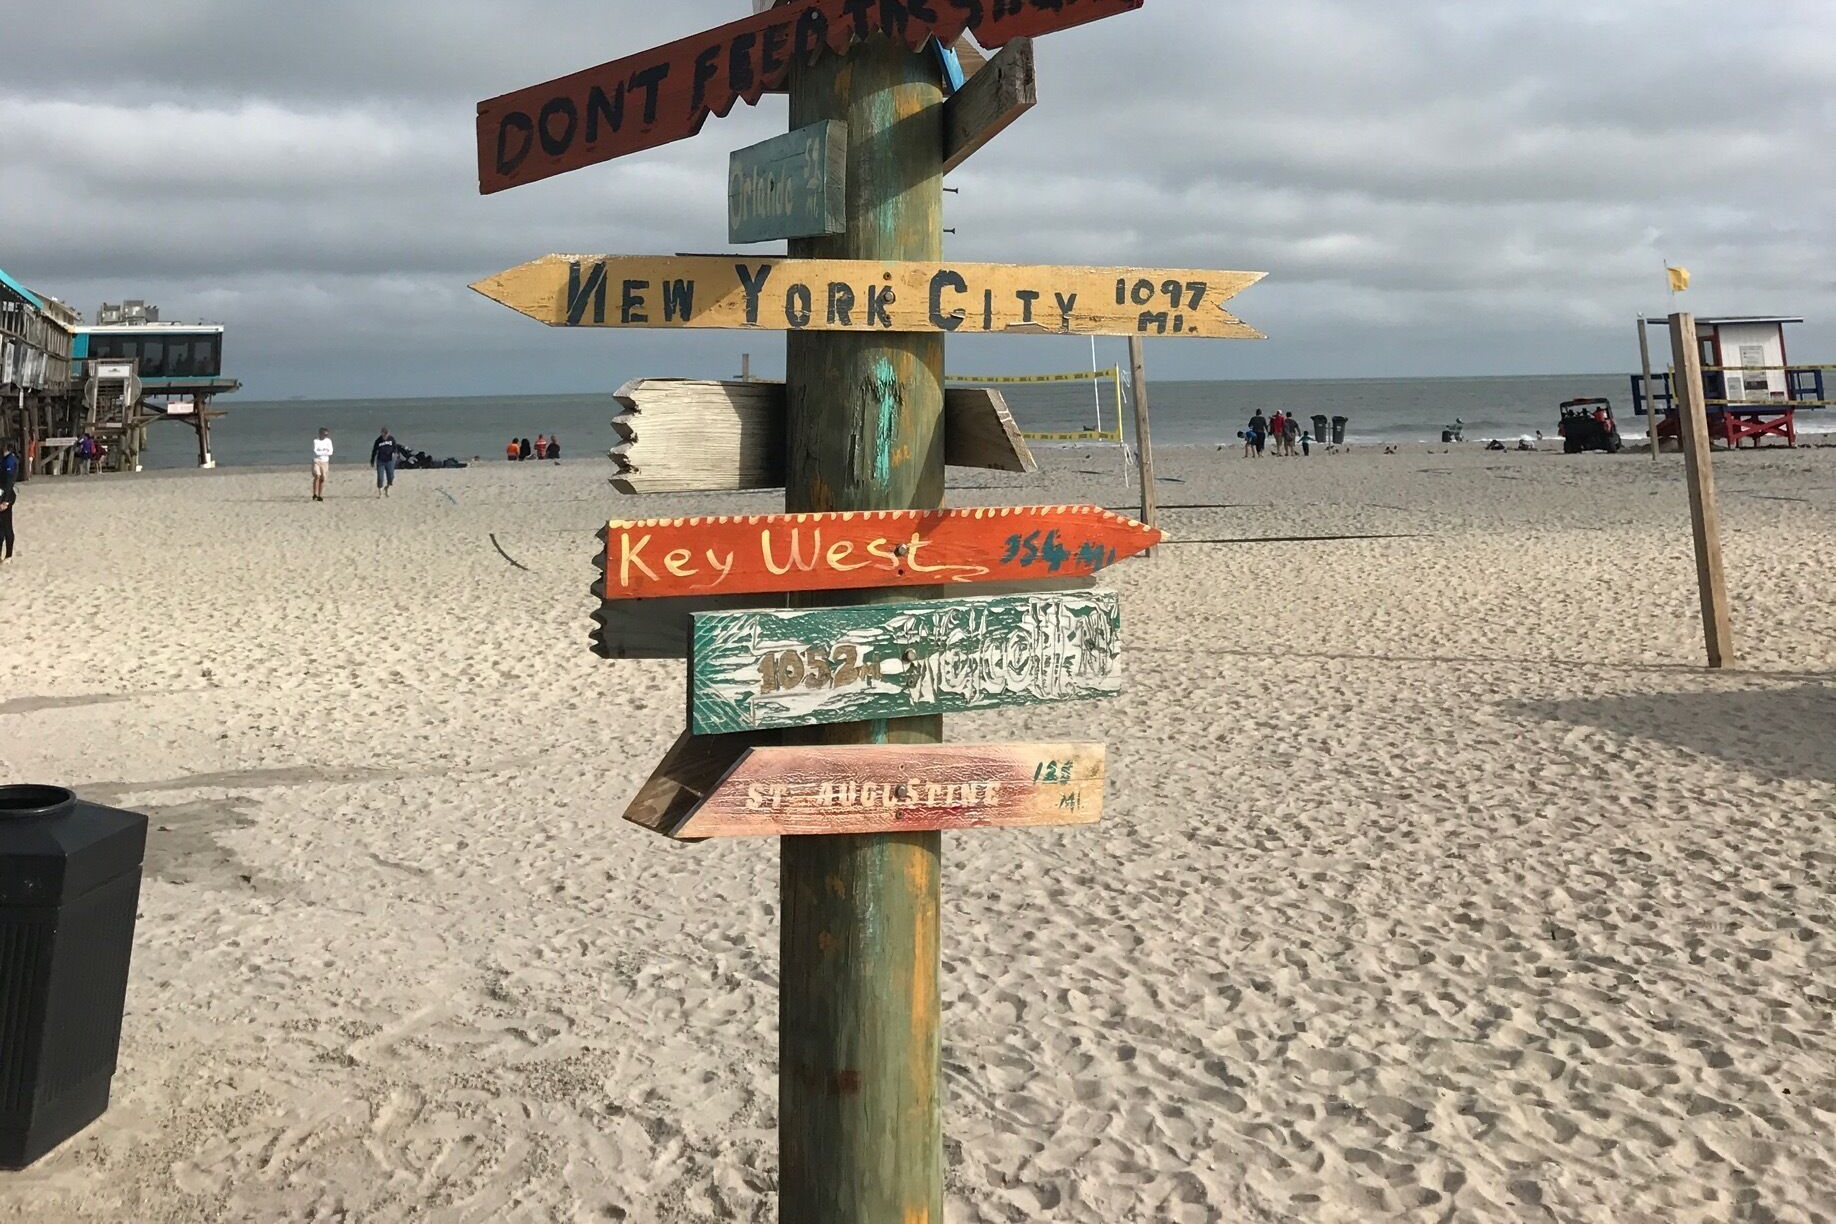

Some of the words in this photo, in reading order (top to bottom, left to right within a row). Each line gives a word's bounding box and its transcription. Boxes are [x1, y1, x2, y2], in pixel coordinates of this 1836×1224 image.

[566, 261, 695, 325] NEW
[734, 264, 895, 328] YORK
[929, 269, 1078, 333] CITY
[1115, 278, 1208, 311] 1097
[619, 531, 734, 590] Key
[761, 527, 990, 583] West
[757, 644, 858, 694] 1052
